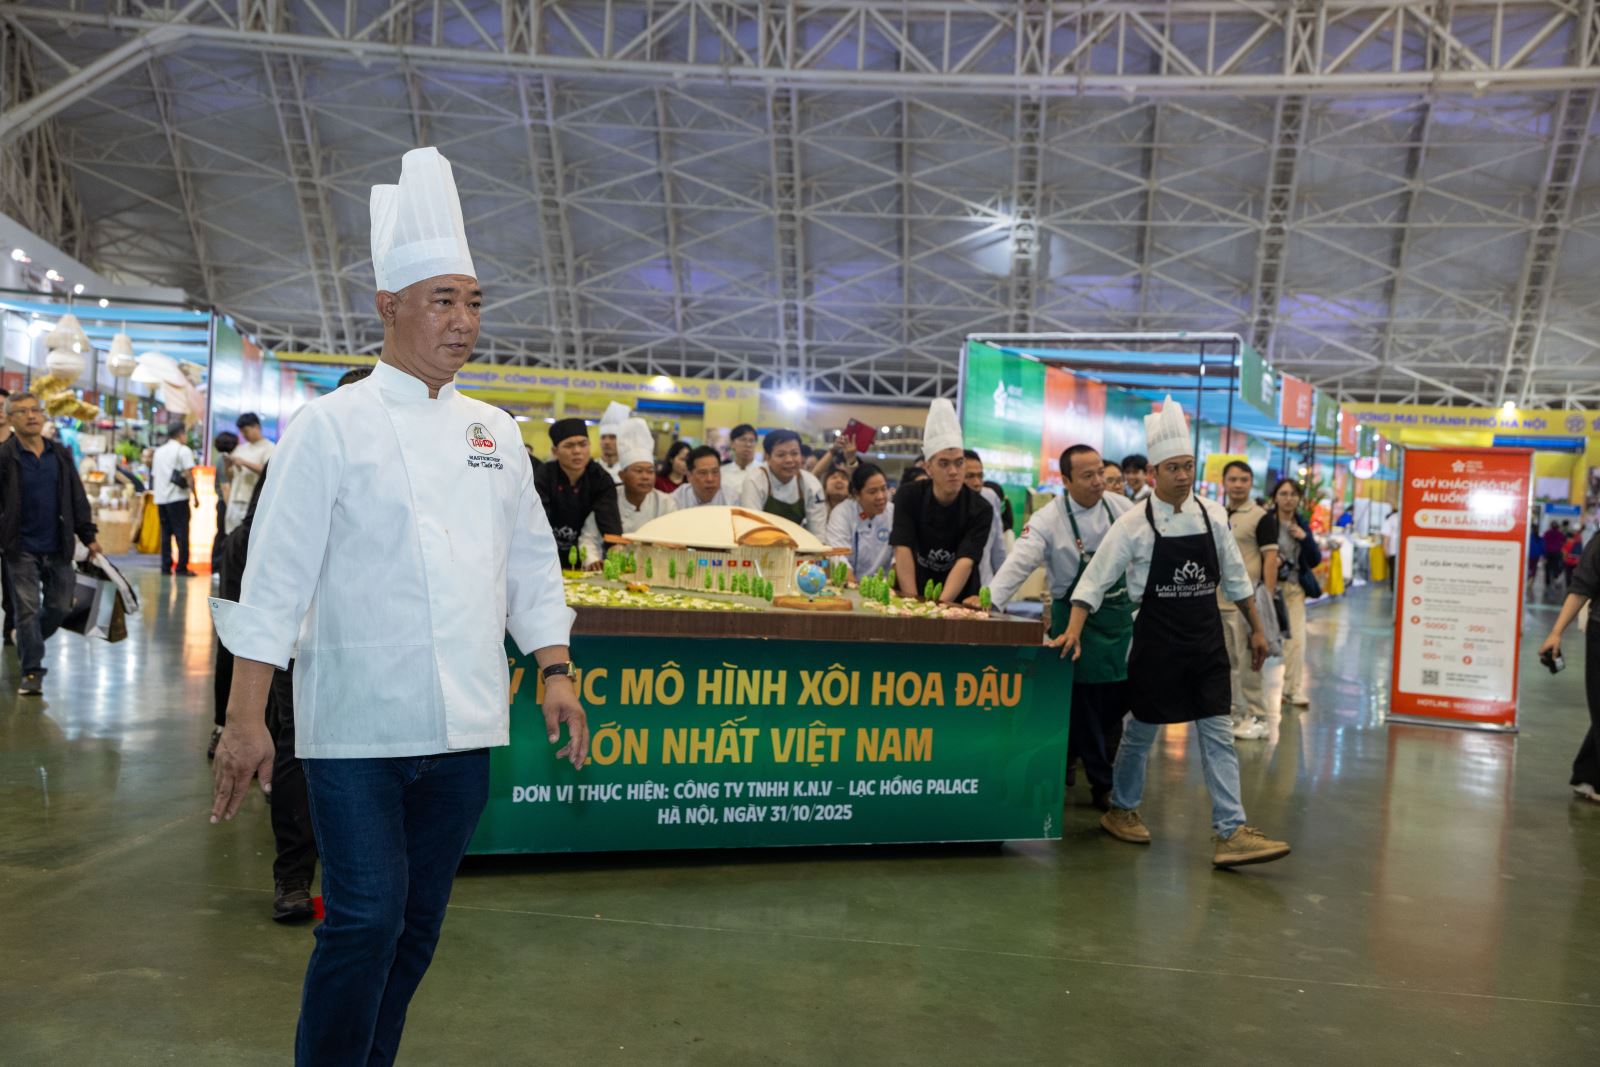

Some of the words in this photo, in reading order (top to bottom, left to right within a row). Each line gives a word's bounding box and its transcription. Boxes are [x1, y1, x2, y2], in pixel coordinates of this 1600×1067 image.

[620, 660, 685, 706] MÔ
[696, 661, 788, 706] HÌNH
[797, 662, 861, 707] XÔI
[870, 671, 945, 707] HOA
[954, 664, 1023, 711] ĐẬU
[583, 720, 650, 766] ỚN
[661, 715, 761, 765] NHẤT
[770, 719, 847, 768] VIỆT
[855, 727, 934, 763] NAM
[511, 784, 551, 803] ĐƠN
[555, 784, 574, 804] VỊ
[577, 782, 623, 803] THỰC
[626, 779, 670, 802] HIỆN:
[673, 779, 720, 800] CÔNG
[723, 782, 744, 798] TY
[747, 781, 789, 798] TNHH
[793, 780, 833, 797] K.N.V
[848, 780, 877, 798] LẠC
[926, 778, 979, 795] PALACE
[657, 804, 681, 825] HÀ
[685, 803, 719, 826] NỘI,
[723, 803, 768, 823] NGÀY
[769, 803, 853, 823] 31/10/2025
